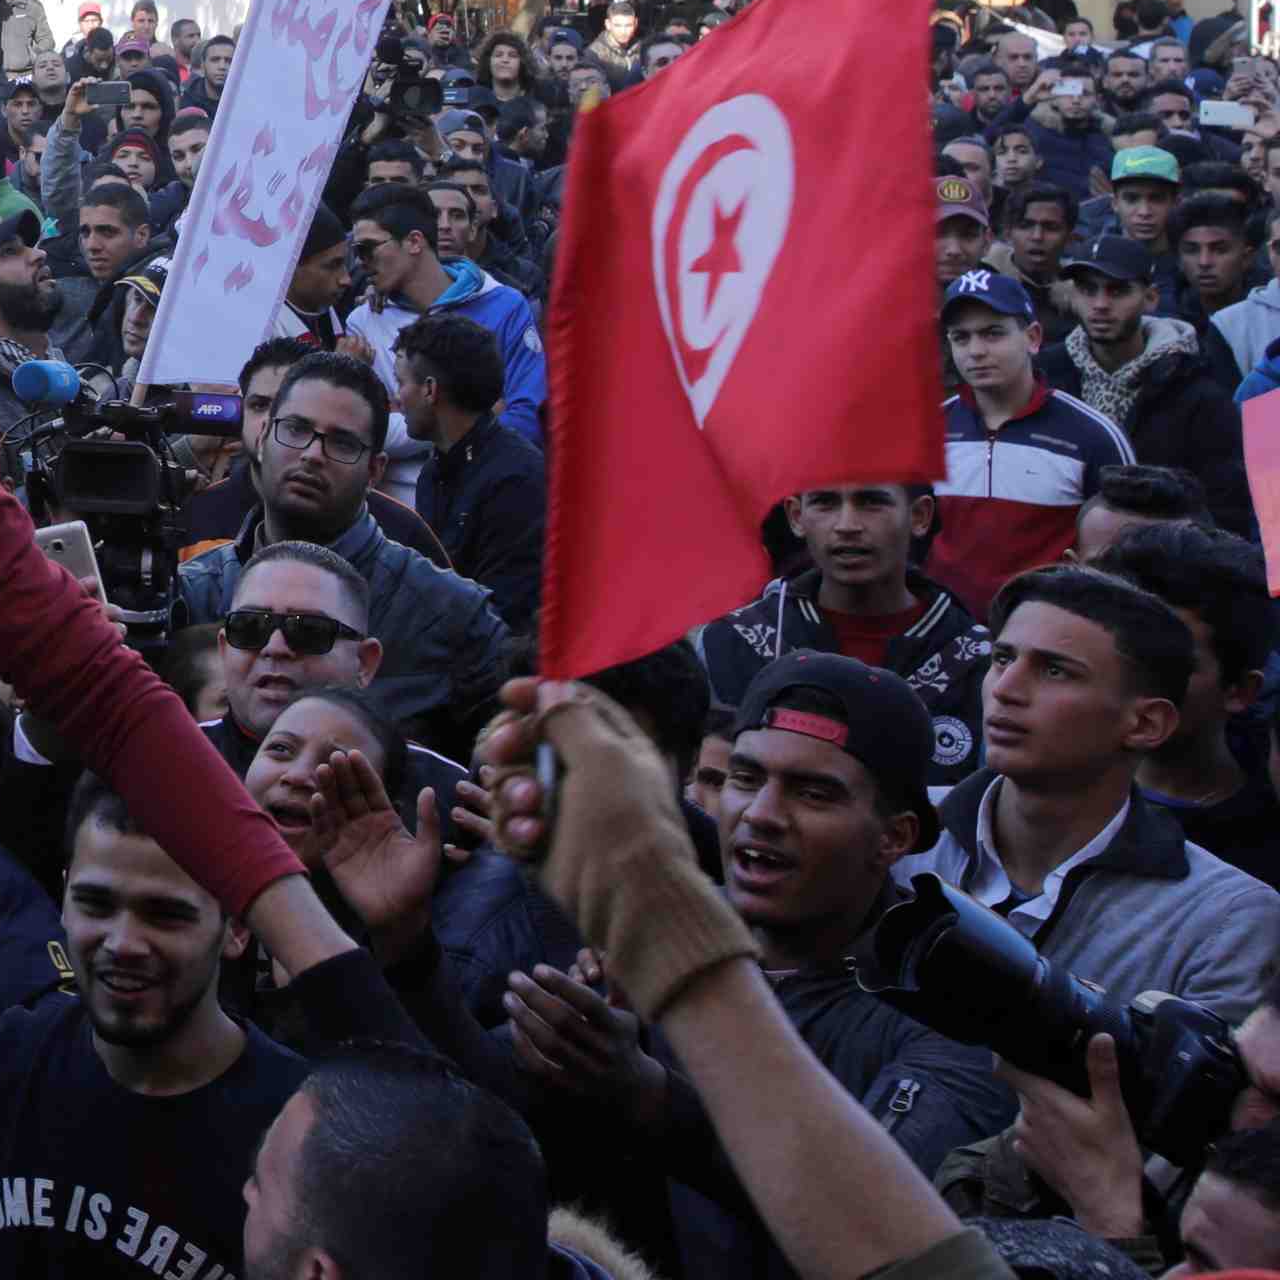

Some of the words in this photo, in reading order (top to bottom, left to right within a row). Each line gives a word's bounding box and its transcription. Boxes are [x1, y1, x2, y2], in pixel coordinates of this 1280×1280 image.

[959, 270, 991, 292] NY
[197, 404, 224, 416] AFP
[65, 1185, 112, 1240] IS
